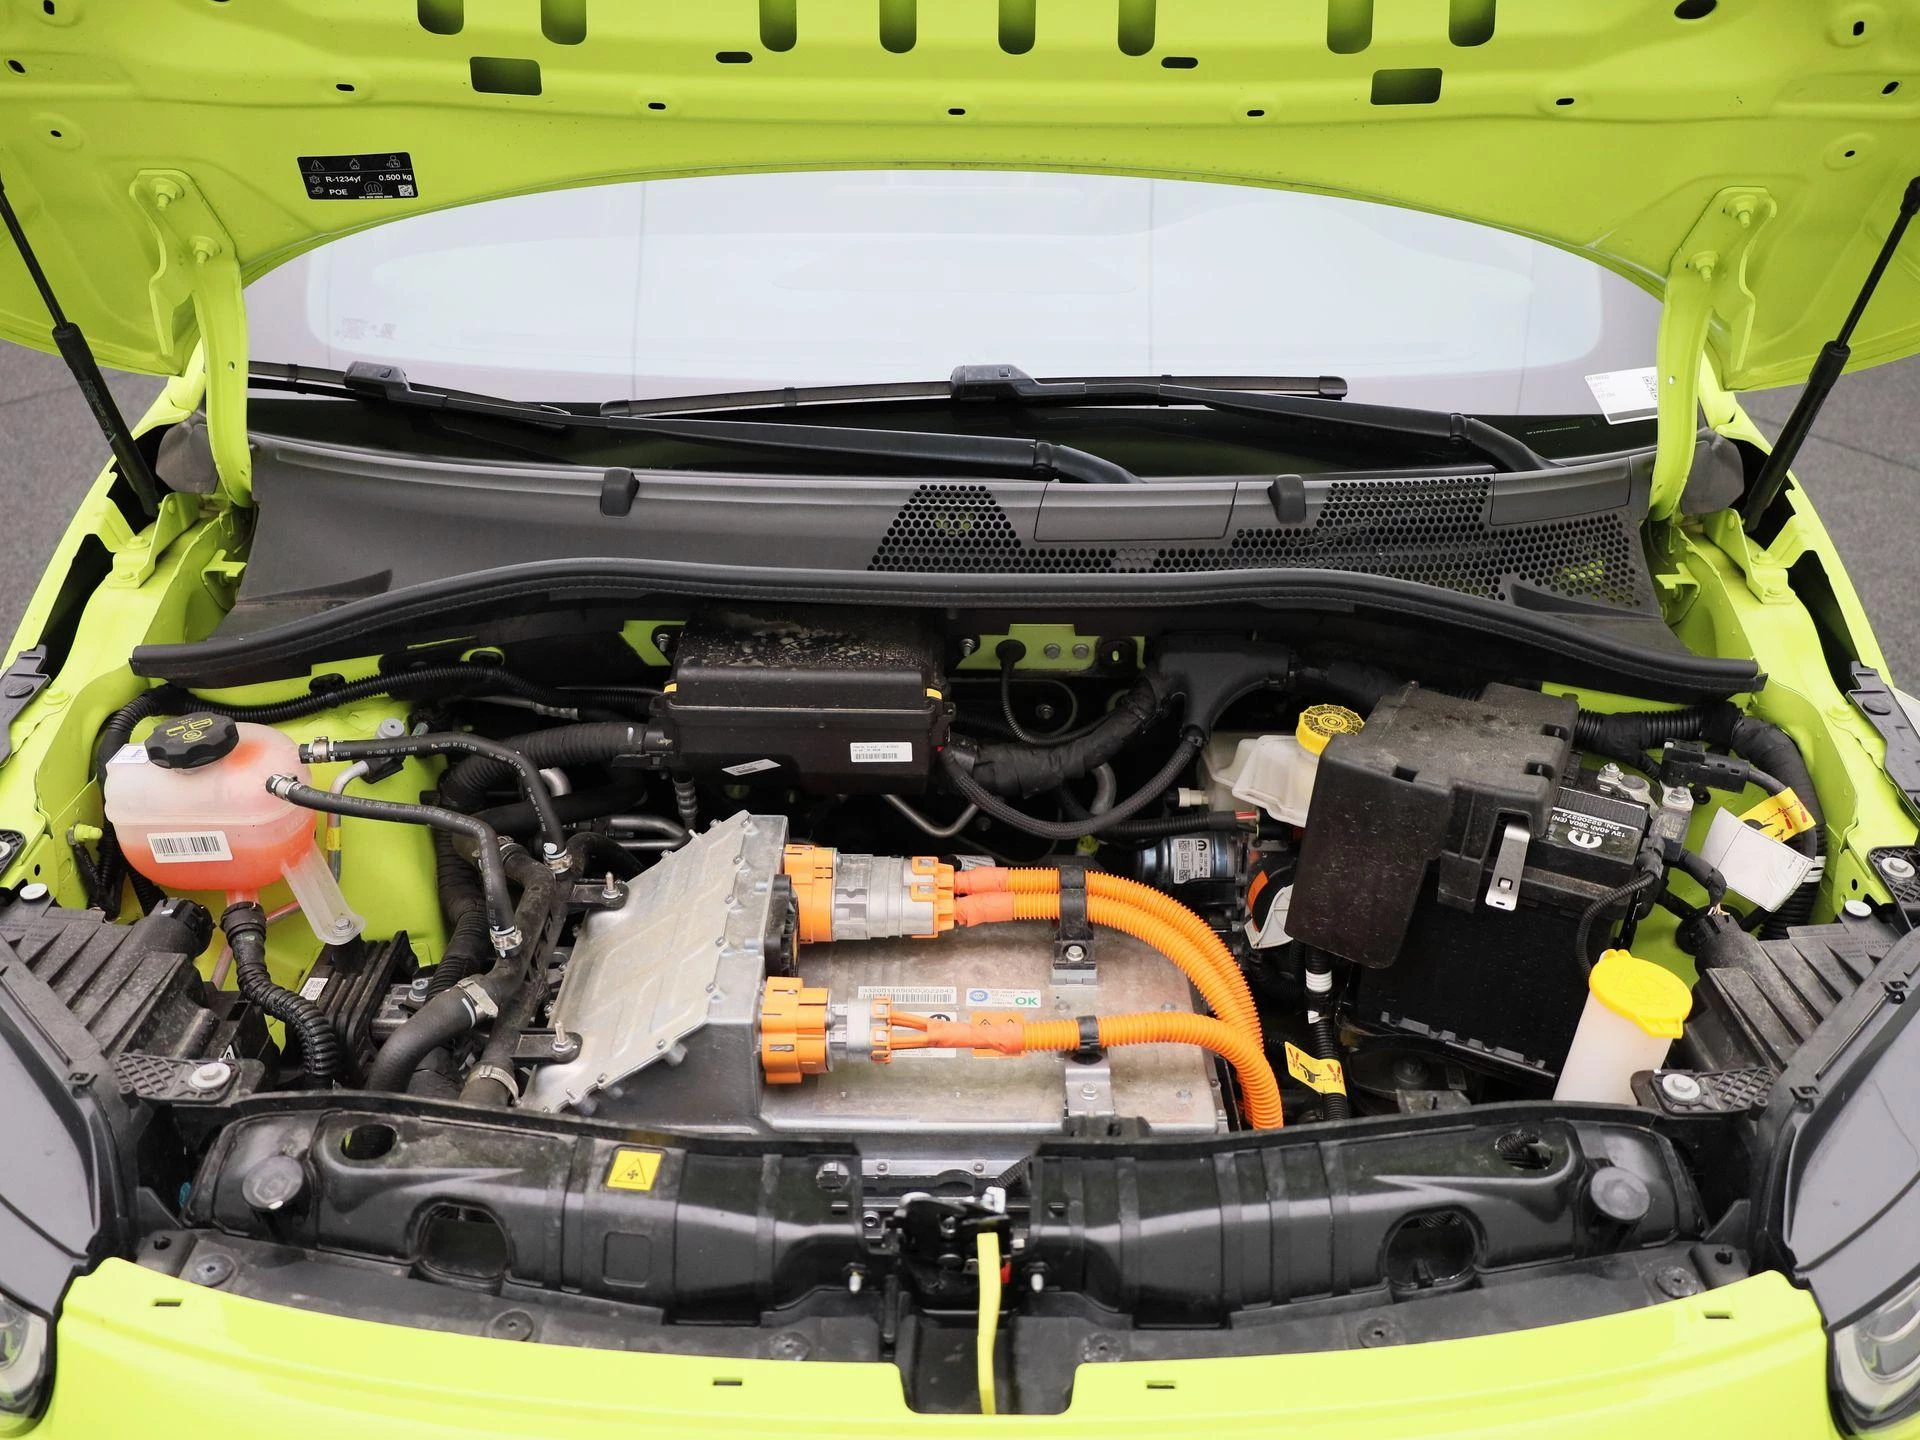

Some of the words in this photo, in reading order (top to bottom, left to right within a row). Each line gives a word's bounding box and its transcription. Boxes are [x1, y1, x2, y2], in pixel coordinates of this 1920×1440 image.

[325, 175, 361, 183] R-1234yf
[378, 174, 401, 182] 0.500
[329, 188, 348, 196] POE
[1551, 814, 1568, 824] (EN)
[1590, 824, 1610, 834] 40Ah
[1611, 830, 1626, 838] 12V
[1014, 997, 1038, 1006] OK
